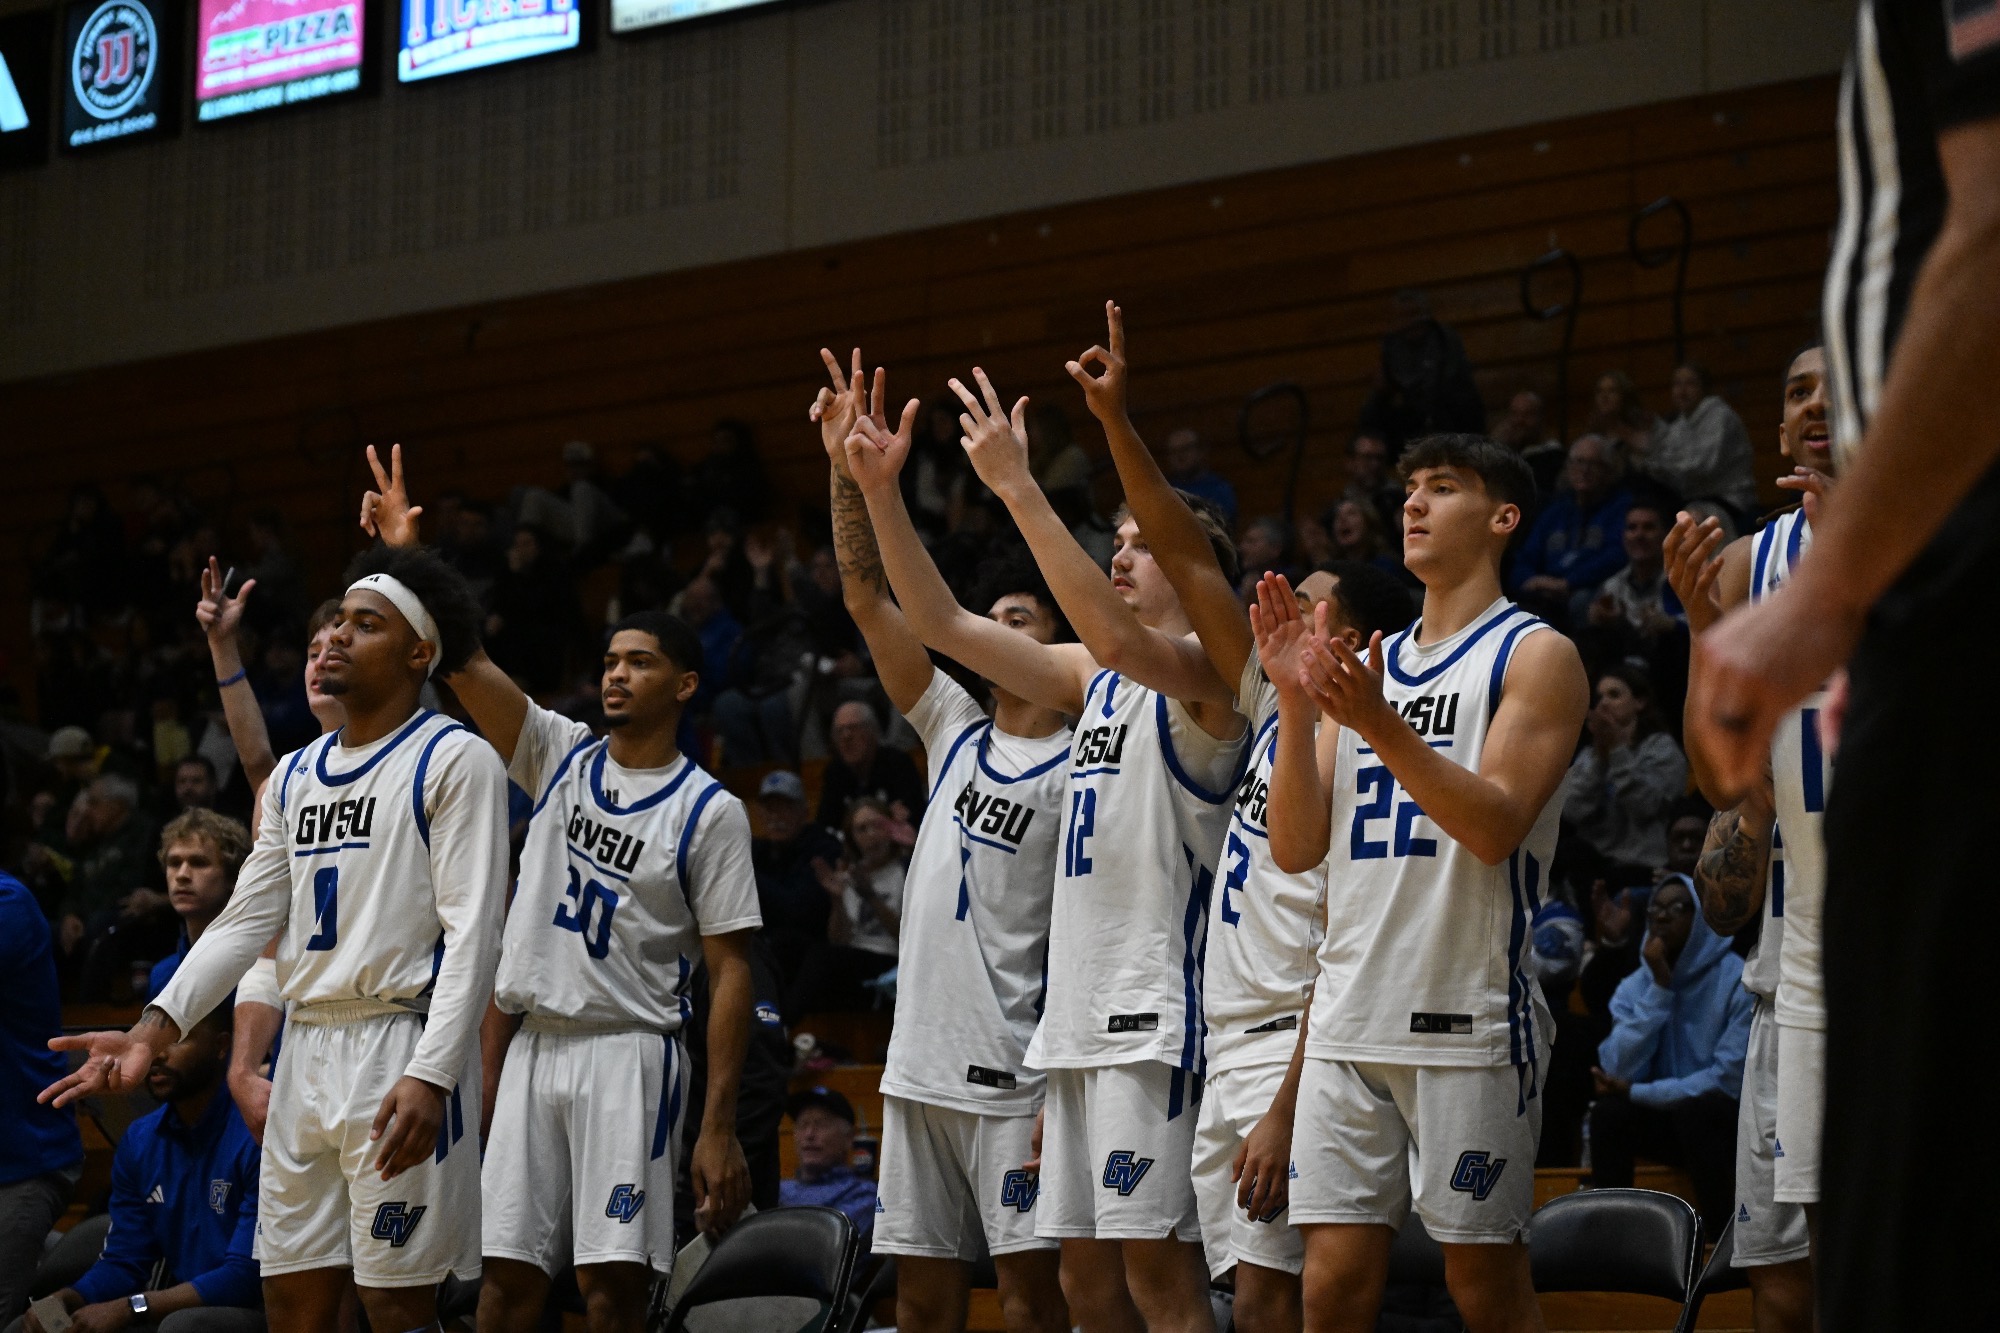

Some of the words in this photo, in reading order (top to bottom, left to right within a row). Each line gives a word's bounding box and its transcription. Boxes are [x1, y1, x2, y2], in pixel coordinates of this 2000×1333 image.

[266, 12, 349, 49] PIZZA
[95, 29, 135, 89] JJ
[296, 797, 376, 845] GVSU
[568, 805, 645, 874] GVSU
[1065, 787, 1096, 878] 12
[1351, 765, 1437, 860] 22
[1221, 831, 1250, 929] 2
[552, 864, 619, 960] 30
[1102, 1150, 1155, 1196] GV
[1450, 1151, 1507, 1201] GV
[371, 1201, 427, 1248] GV
[605, 1184, 646, 1223] GV
